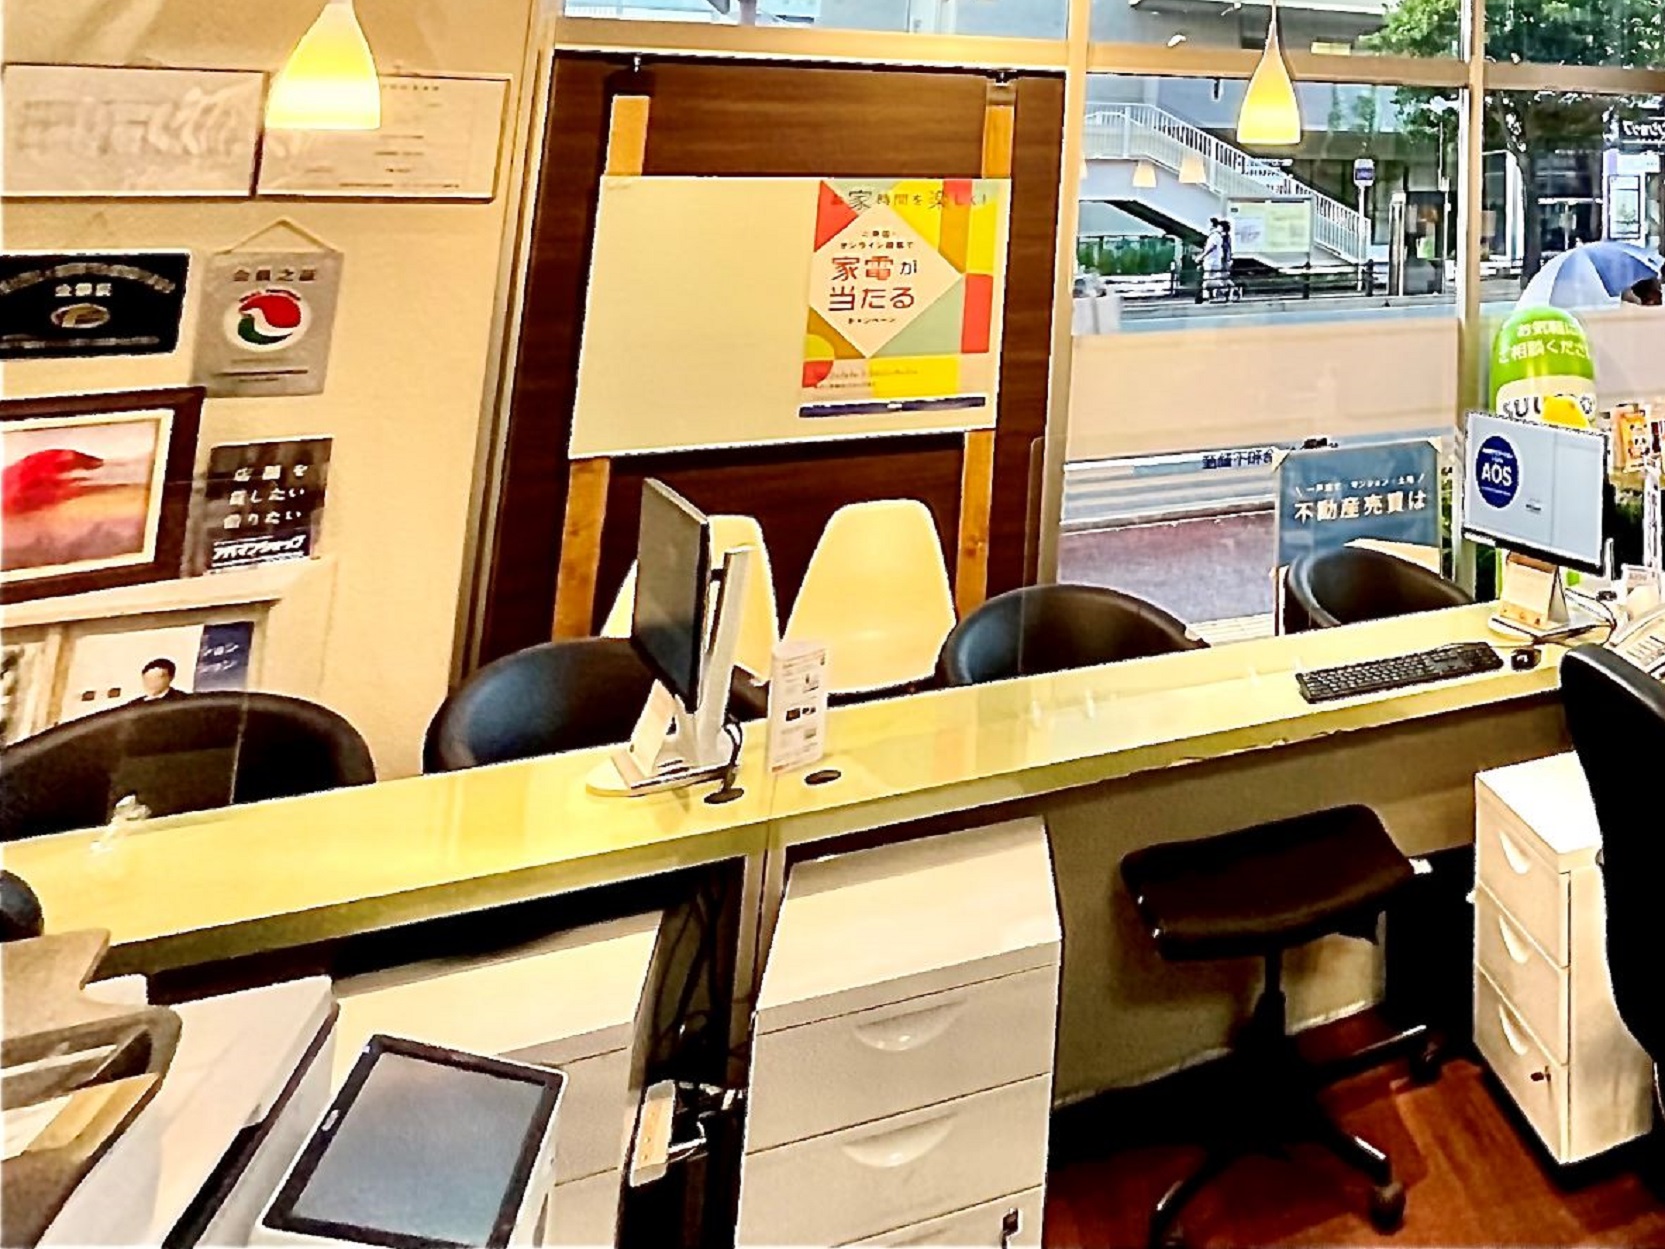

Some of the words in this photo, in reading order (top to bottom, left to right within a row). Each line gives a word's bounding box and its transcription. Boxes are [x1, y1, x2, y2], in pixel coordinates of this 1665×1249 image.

[831, 255, 918, 282] 家電が
[828, 285, 915, 311] 当たる
[1502, 393, 1593, 419] SUUO
[1481, 462, 1513, 487] AOS
[1294, 489, 1427, 524] 不動産売買は
